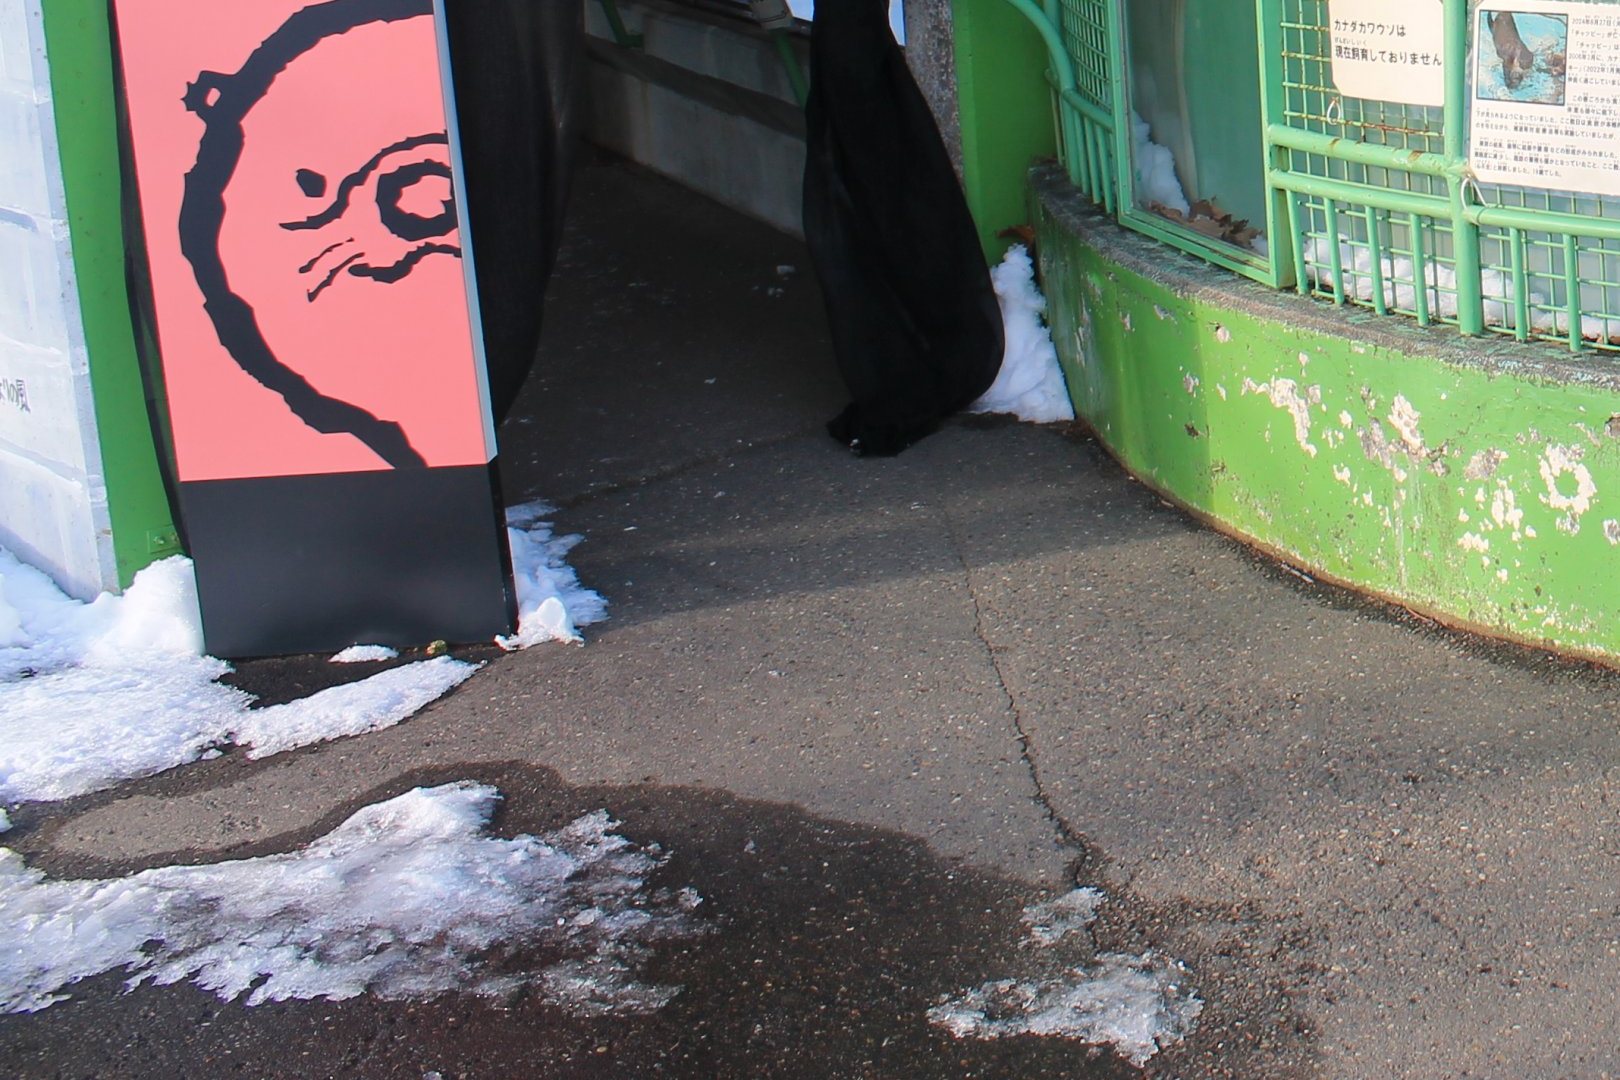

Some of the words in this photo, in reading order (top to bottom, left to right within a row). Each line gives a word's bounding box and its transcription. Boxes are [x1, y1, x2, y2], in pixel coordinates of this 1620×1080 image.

[1334, 18, 1406, 37] カナダカワウソは
[1335, 45, 1442, 66] 現在飼育しておりません
